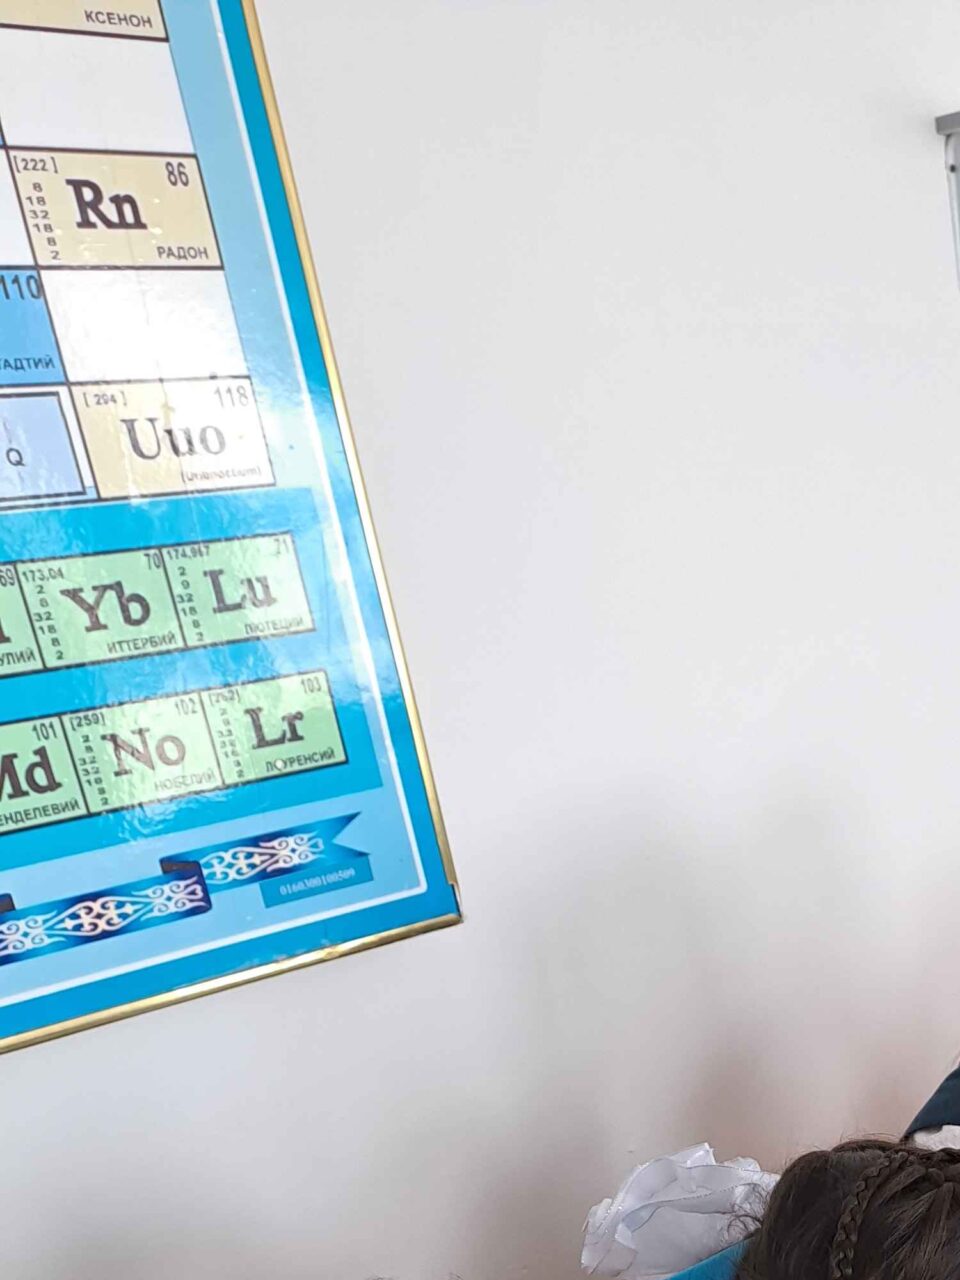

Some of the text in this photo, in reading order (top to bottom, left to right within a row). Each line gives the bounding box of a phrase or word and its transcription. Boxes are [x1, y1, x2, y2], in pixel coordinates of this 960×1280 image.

[84, 10, 153, 28] КСЕНОН
[165, 161, 189, 187] 86
[25, 196, 46, 206] 18
[65, 178, 148, 230] Rn
[29, 210, 50, 219] 32
[32, 223, 53, 233] 18
[50, 250, 61, 260] 2
[156, 246, 209, 261] РАДОН
[0, 274, 41, 300] 110
[0, 354, 55, 371] АДТИЙ
[214, 385, 249, 408] 118
[120, 417, 226, 460] Uuo
[6, 447, 25, 467] Q
[144, 553, 161, 570] 70
[203, 569, 278, 614] Lu
[59, 580, 151, 632] Yb
[33, 611, 54, 622] 32
[106, 631, 178, 654] ИТТЕРБИЙ
[301, 676, 322, 695] 103
[32, 721, 57, 742] 101
[244, 706, 305, 750] Lr
[100, 727, 187, 777] No
